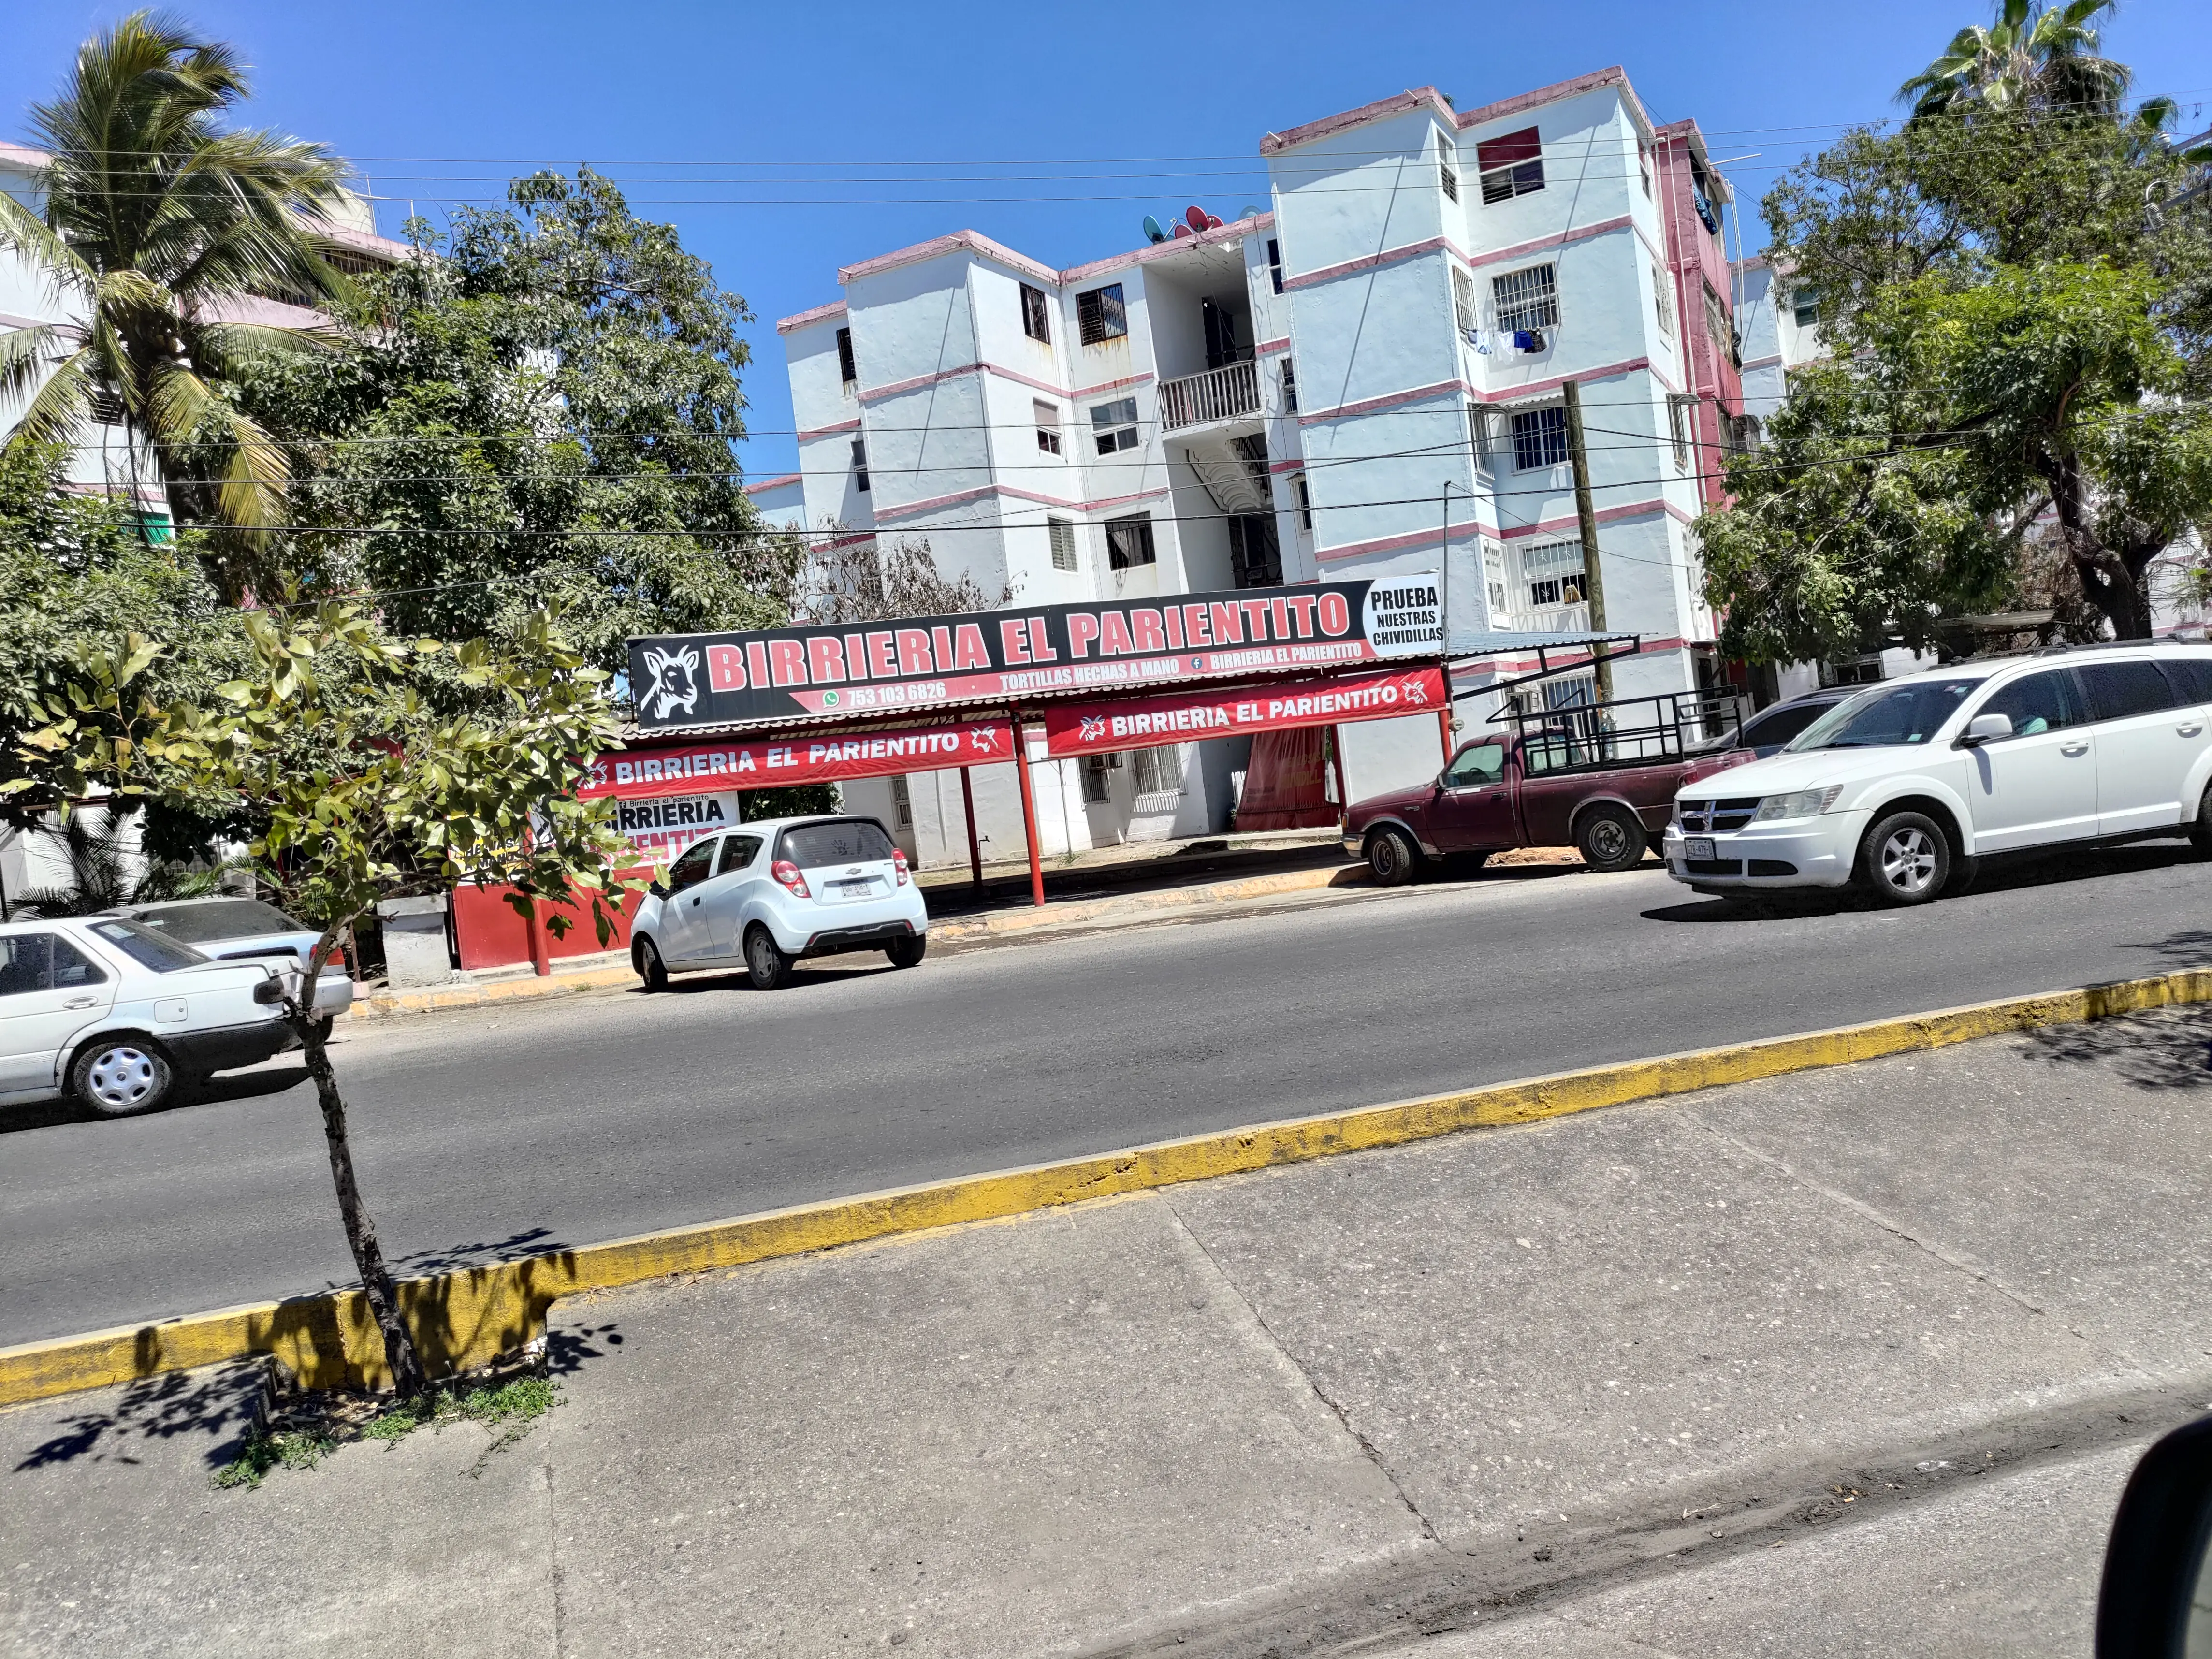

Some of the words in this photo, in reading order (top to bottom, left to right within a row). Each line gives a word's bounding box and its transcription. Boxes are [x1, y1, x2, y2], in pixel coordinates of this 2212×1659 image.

[1371, 587, 1439, 611] PRUEBA
[1377, 611, 1436, 627] NUESTRAS
[706, 623, 991, 693] BIRRIERIA
[1000, 616, 1057, 666] EL
[1066, 592, 1350, 659] PARIENTITO
[1373, 627, 1444, 646] CHIVIDILLAS
[1210, 651, 1275, 669] BIRRIERIA
[1276, 650, 1290, 665] EL
[1292, 642, 1362, 663] PARIENTITO
[1000, 668, 1073, 691] TORTILLAS
[1074, 664, 1128, 684] HECHAS
[1130, 663, 1141, 679] A
[1142, 658, 1180, 678] MANO
[847, 689, 876, 707] 753
[878, 686, 906, 704] 103
[908, 682, 946, 701] 6826
[1111, 707, 1230, 737] BIRRIERIA
[1237, 704, 1264, 723] EL
[1269, 685, 1398, 719] PARIENTITO
[616, 750, 757, 785] BIRRIERIA
[767, 747, 798, 768] EL
[809, 733, 960, 763] PARIENTITO
[673, 794, 709, 804] parientito
[595, 800, 725, 831] IRRIERIA
